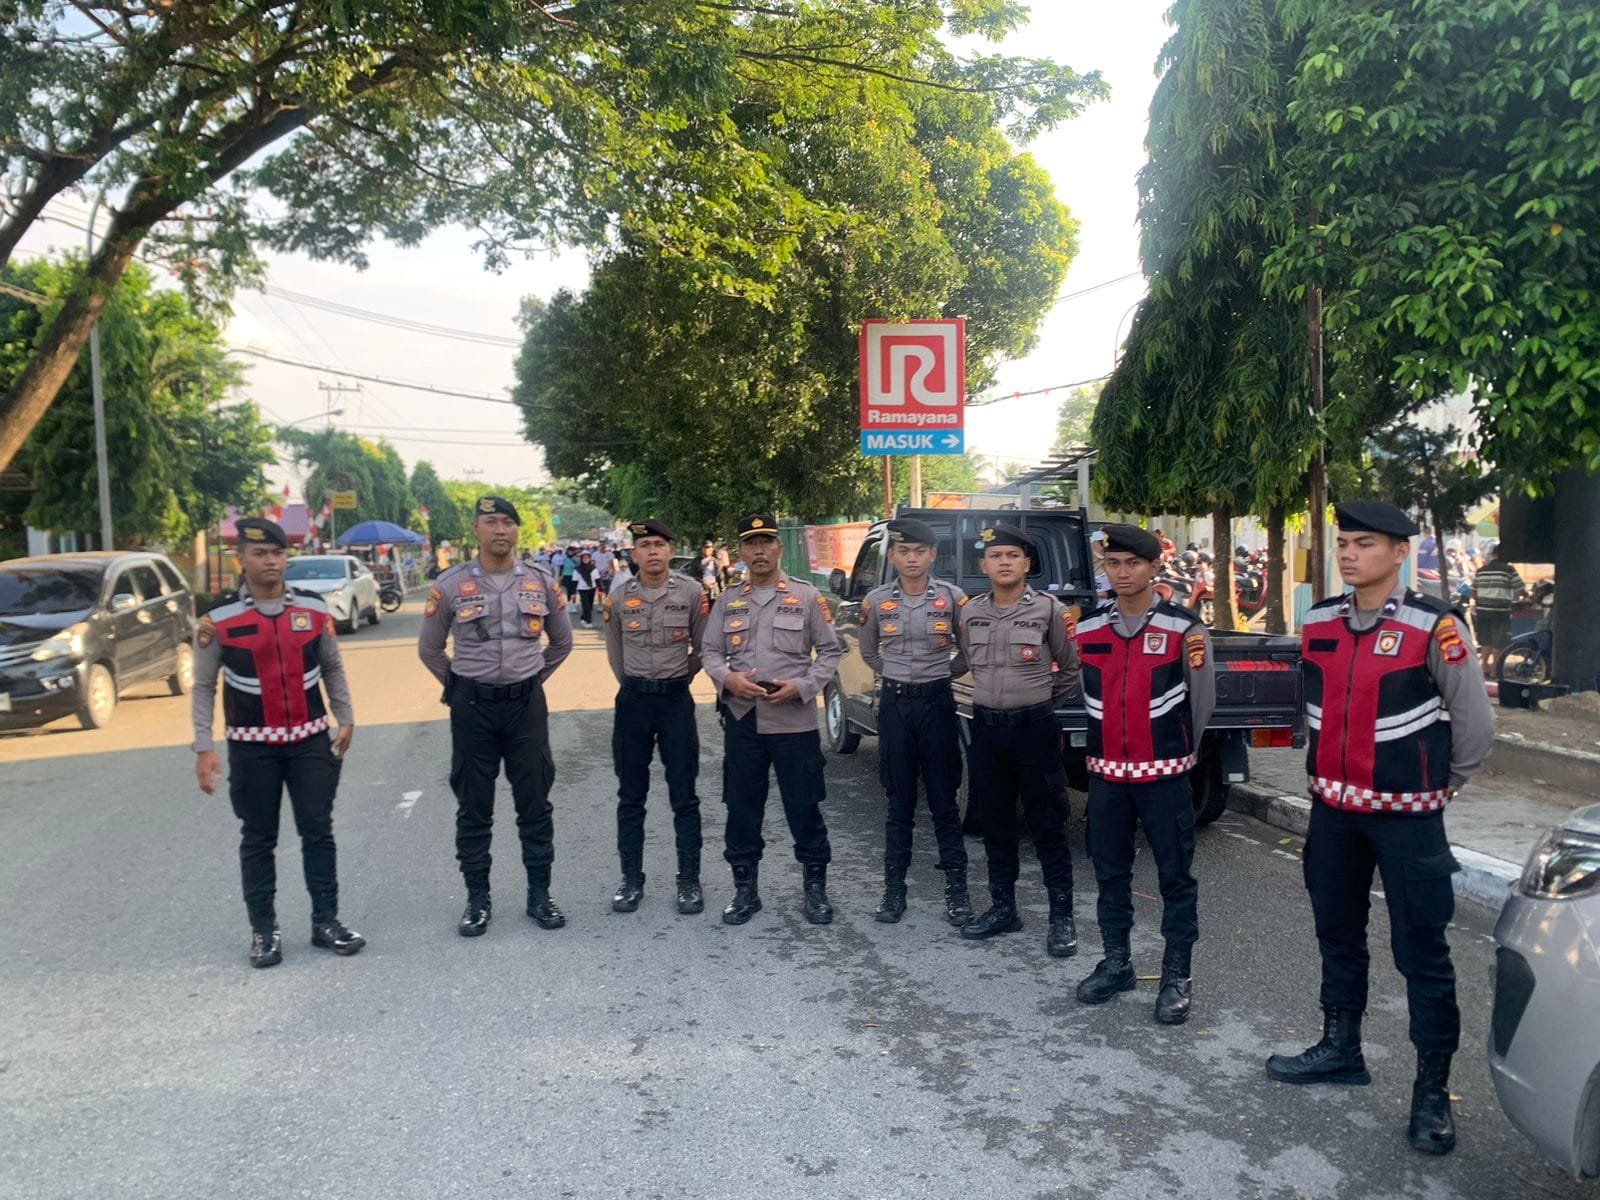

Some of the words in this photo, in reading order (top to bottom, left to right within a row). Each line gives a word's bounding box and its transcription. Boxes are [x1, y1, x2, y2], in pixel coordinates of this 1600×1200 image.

[867, 409, 958, 426] Ramayana
[866, 434, 934, 449] MASUK
[776, 606, 804, 614] POLRI
[1013, 620, 1041, 629] POLRI
